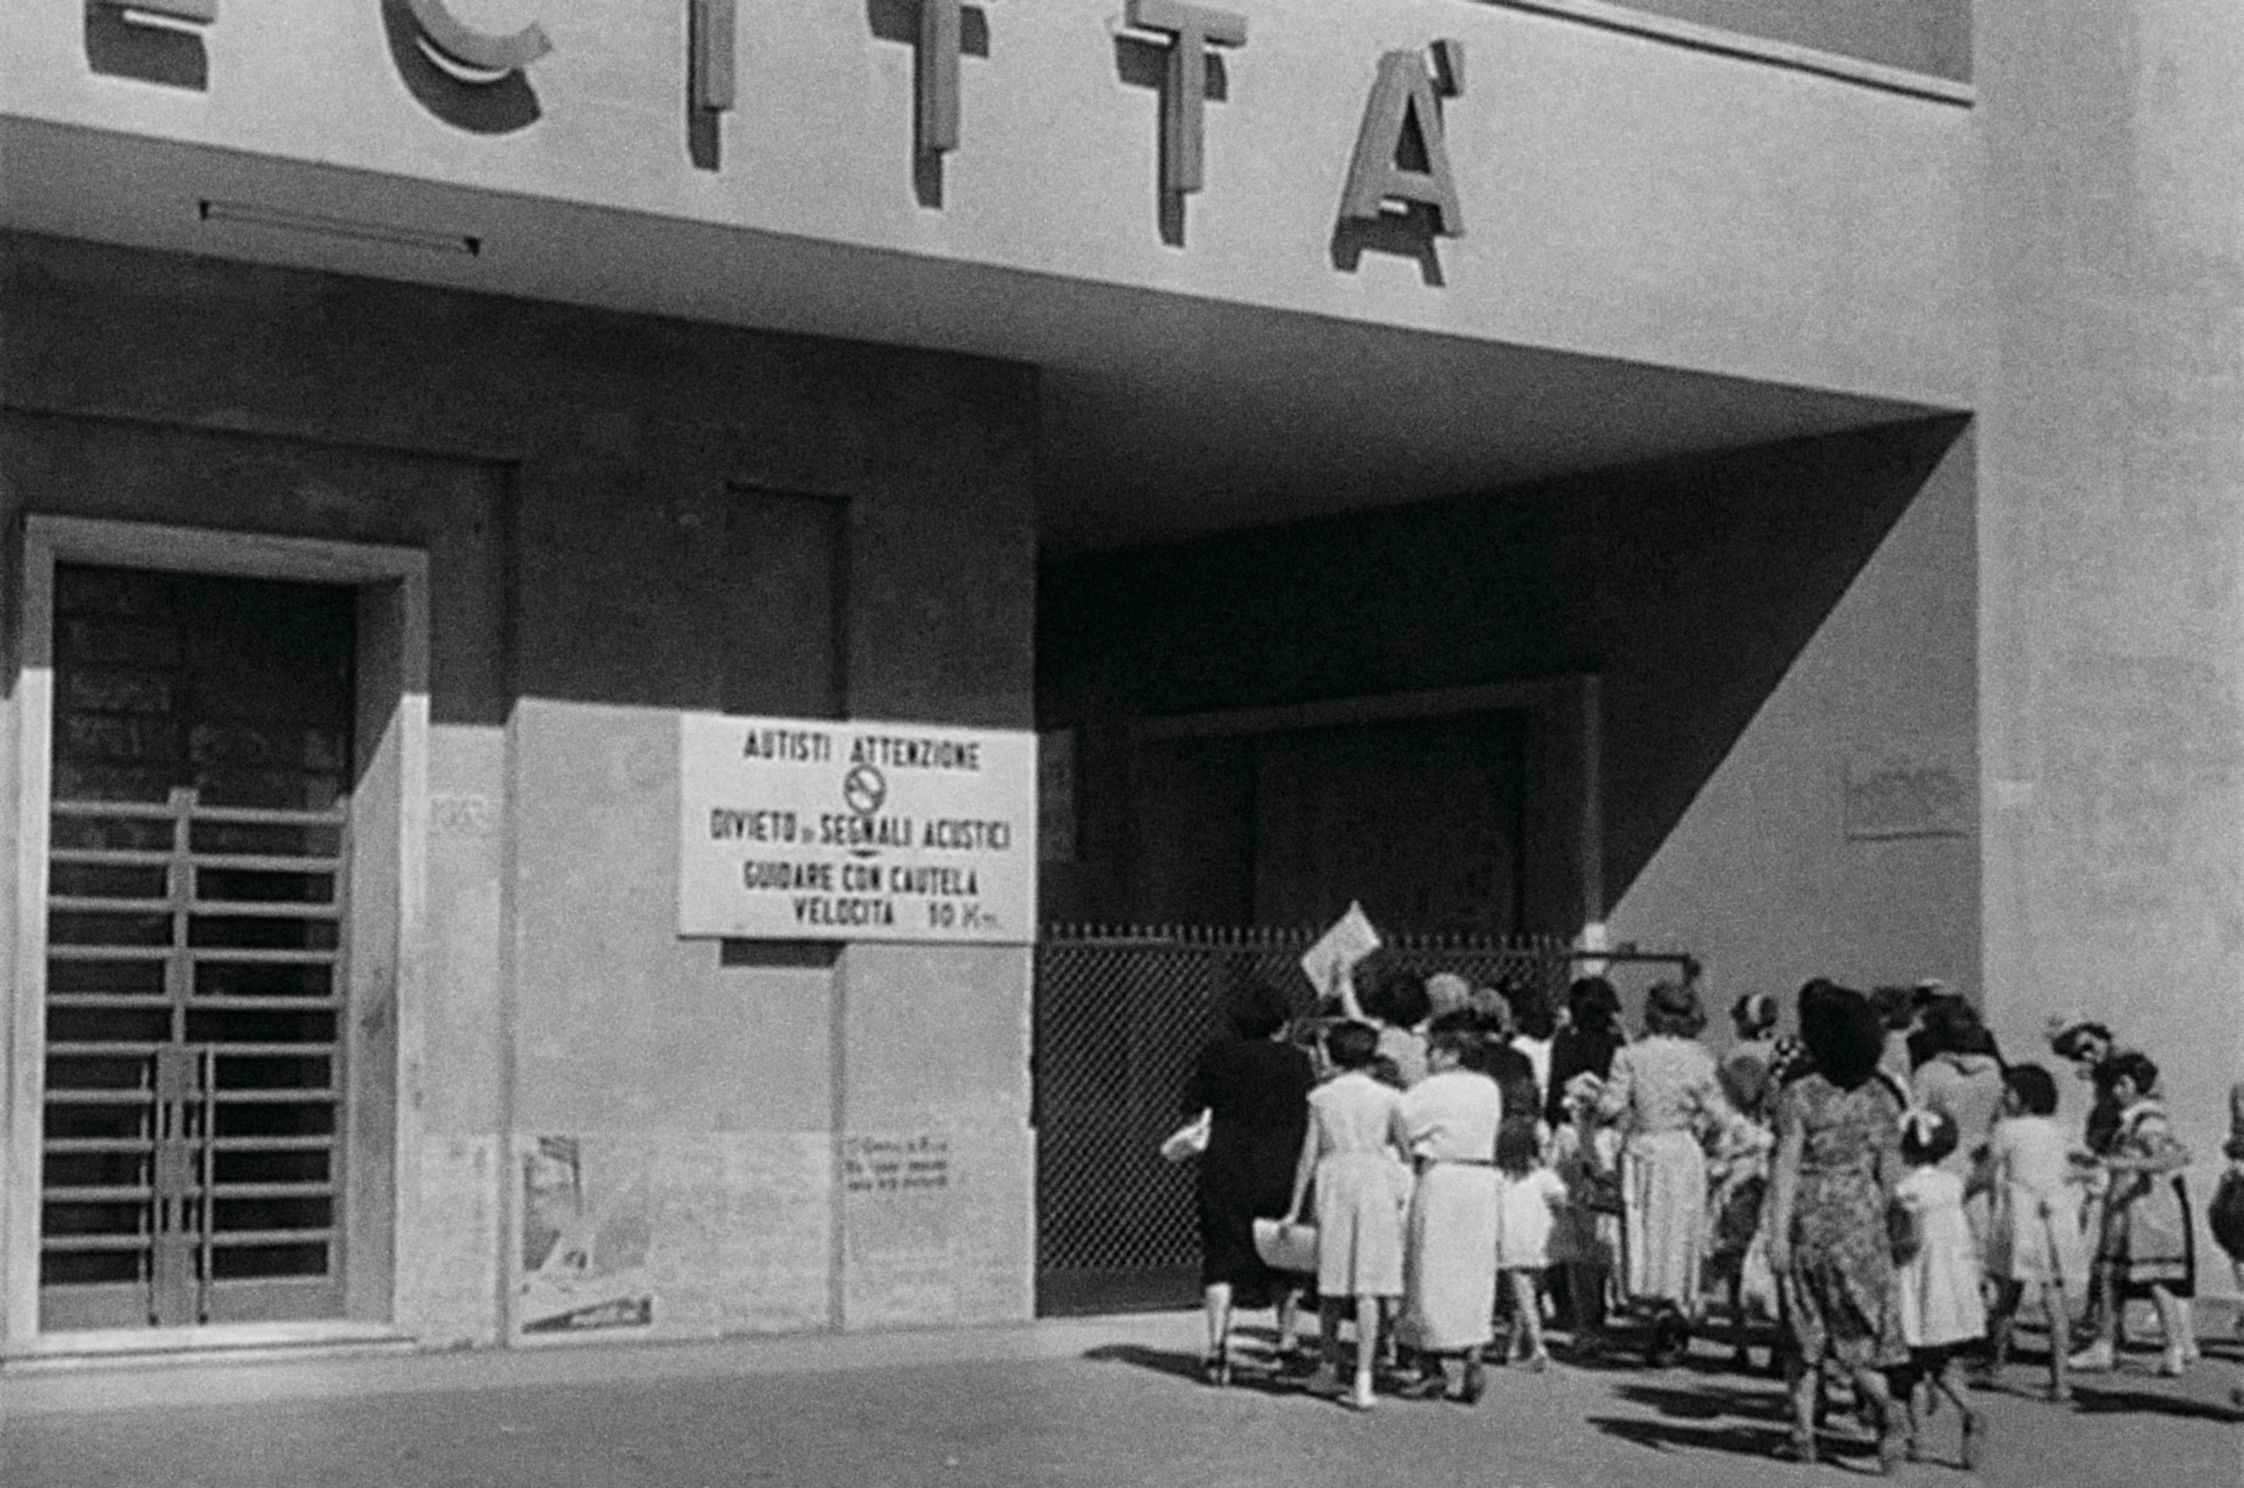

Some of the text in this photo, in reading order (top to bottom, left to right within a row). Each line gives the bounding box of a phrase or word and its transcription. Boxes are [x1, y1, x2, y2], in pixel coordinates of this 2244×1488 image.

[743, 729, 980, 771] AUTISTI ATTENZIONE
[710, 808, 797, 842] DIVIETO
[820, 813, 912, 846] SEGNALI
[924, 818, 1010, 849] ACUSTICI
[744, 860, 979, 896] GUIDARE CON CAUTELA
[928, 902, 955, 927] 10
